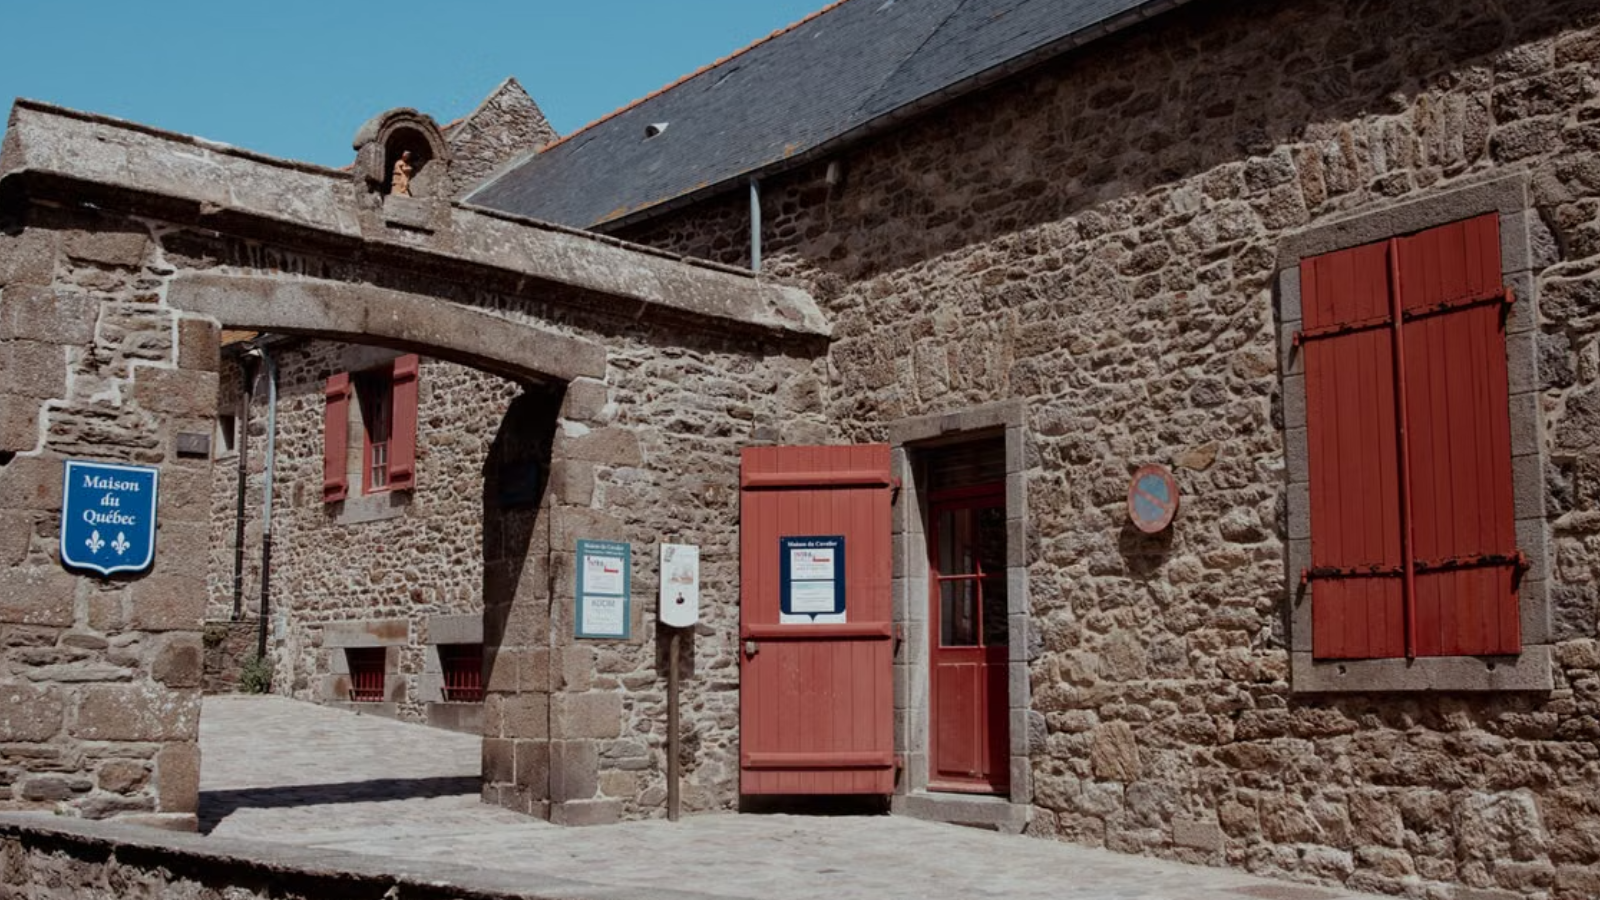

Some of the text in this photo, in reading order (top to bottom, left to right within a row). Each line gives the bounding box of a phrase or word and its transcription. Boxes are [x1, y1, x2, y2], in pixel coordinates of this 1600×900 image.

[82, 475, 140, 492] Maison
[100, 492, 120, 507] du
[83, 509, 136, 526] Québec
